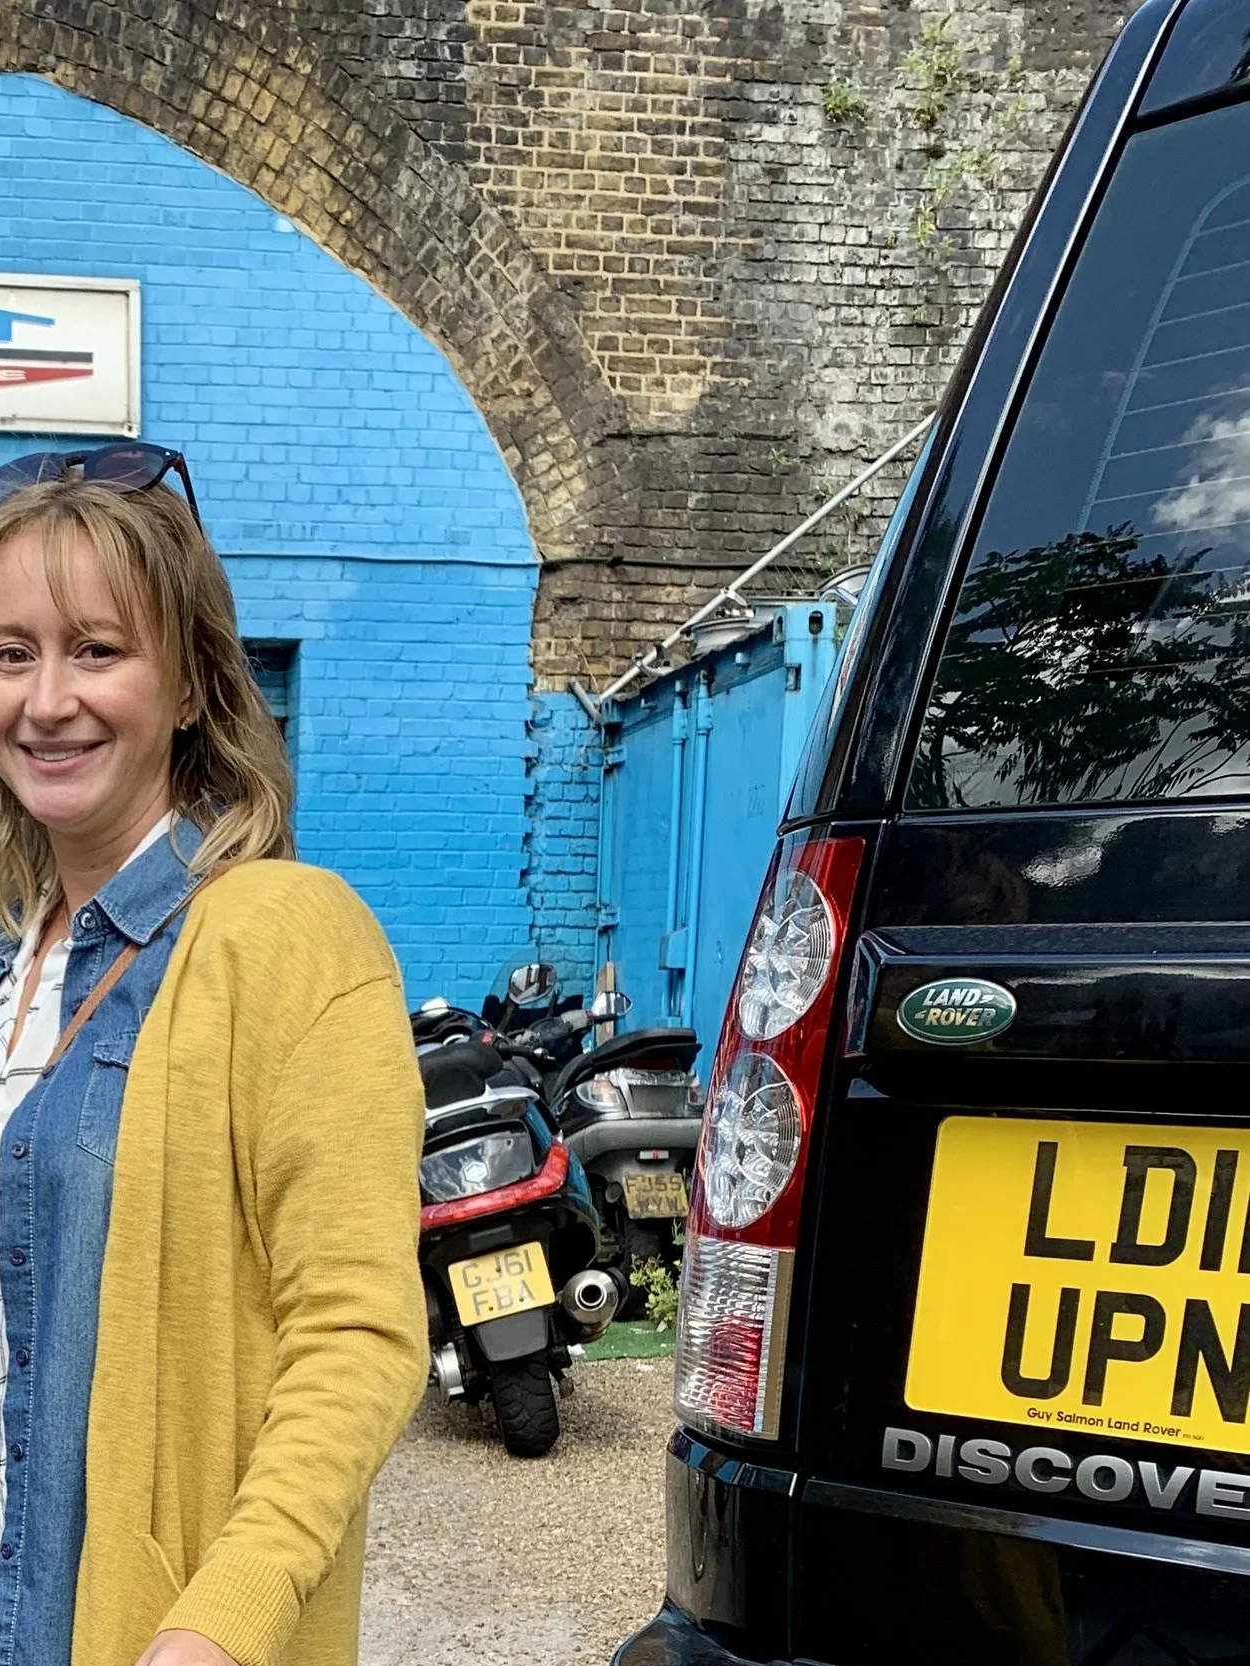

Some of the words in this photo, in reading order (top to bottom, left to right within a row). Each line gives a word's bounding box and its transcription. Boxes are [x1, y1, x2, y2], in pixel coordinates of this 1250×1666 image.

[922, 989, 981, 1006] LAND
[924, 1008, 996, 1027] ROVER
[1023, 1141, 1250, 1274] LD1
[462, 1249, 532, 1288] GJ61
[472, 1279, 536, 1316] FBA
[1027, 1407, 1052, 1422] Guy
[1056, 1411, 1103, 1428] Salmon
[1107, 1417, 1140, 1432] Land
[1143, 1422, 1181, 1438] Rover
